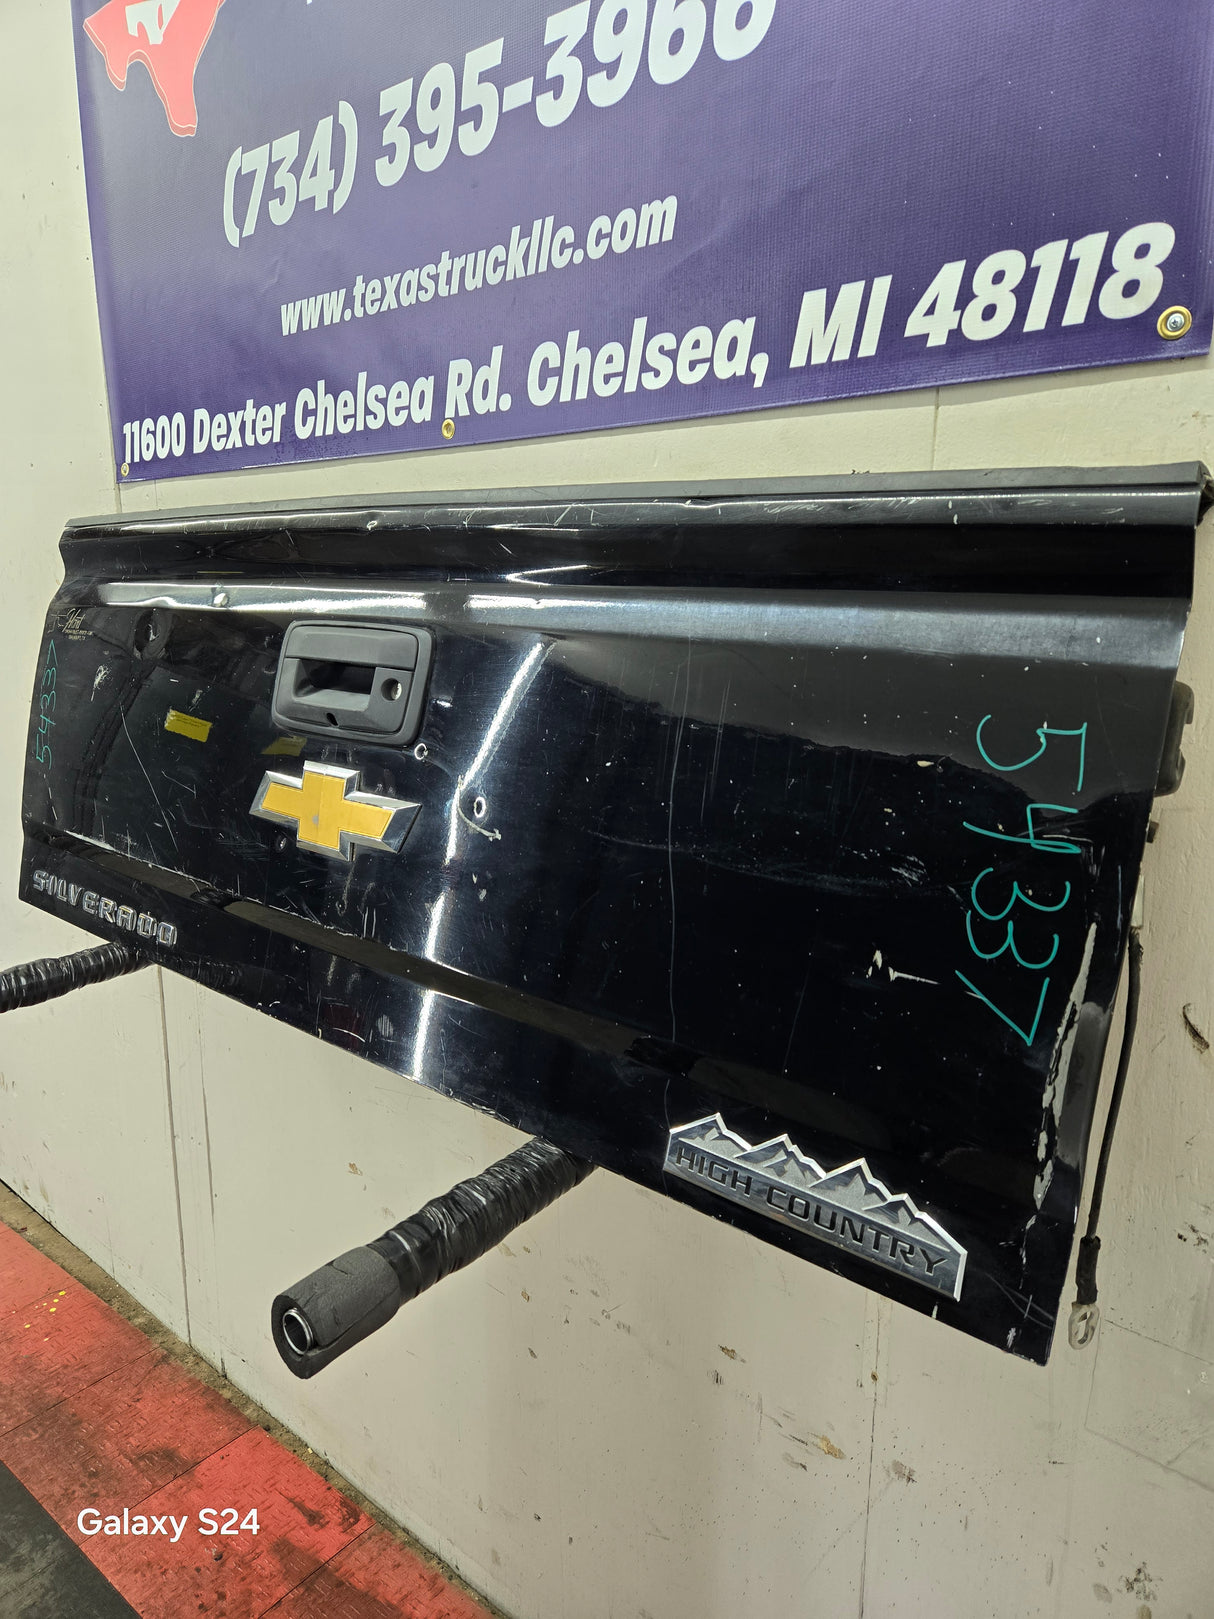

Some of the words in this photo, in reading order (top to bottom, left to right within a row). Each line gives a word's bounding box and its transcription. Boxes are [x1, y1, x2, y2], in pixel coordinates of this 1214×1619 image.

[223, 100, 359, 248] (734)
[281, 196, 678, 336] www.texastruckllc.com
[122, 422, 186, 464] 11600
[193, 399, 286, 454] Dexter
[294, 373, 435, 441] Chelsea
[444, 346, 511, 418] Rd.
[527, 316, 769, 406] Chelsea,
[789, 274, 893, 369] MI
[904, 222, 1176, 347] 48118
[36, 640, 58, 769] 54337
[33, 870, 178, 948] SILVERADO
[955, 714, 1088, 1047] 54337
[675, 1148, 752, 1197] HIGH
[766, 1185, 947, 1276] COUNTRY
